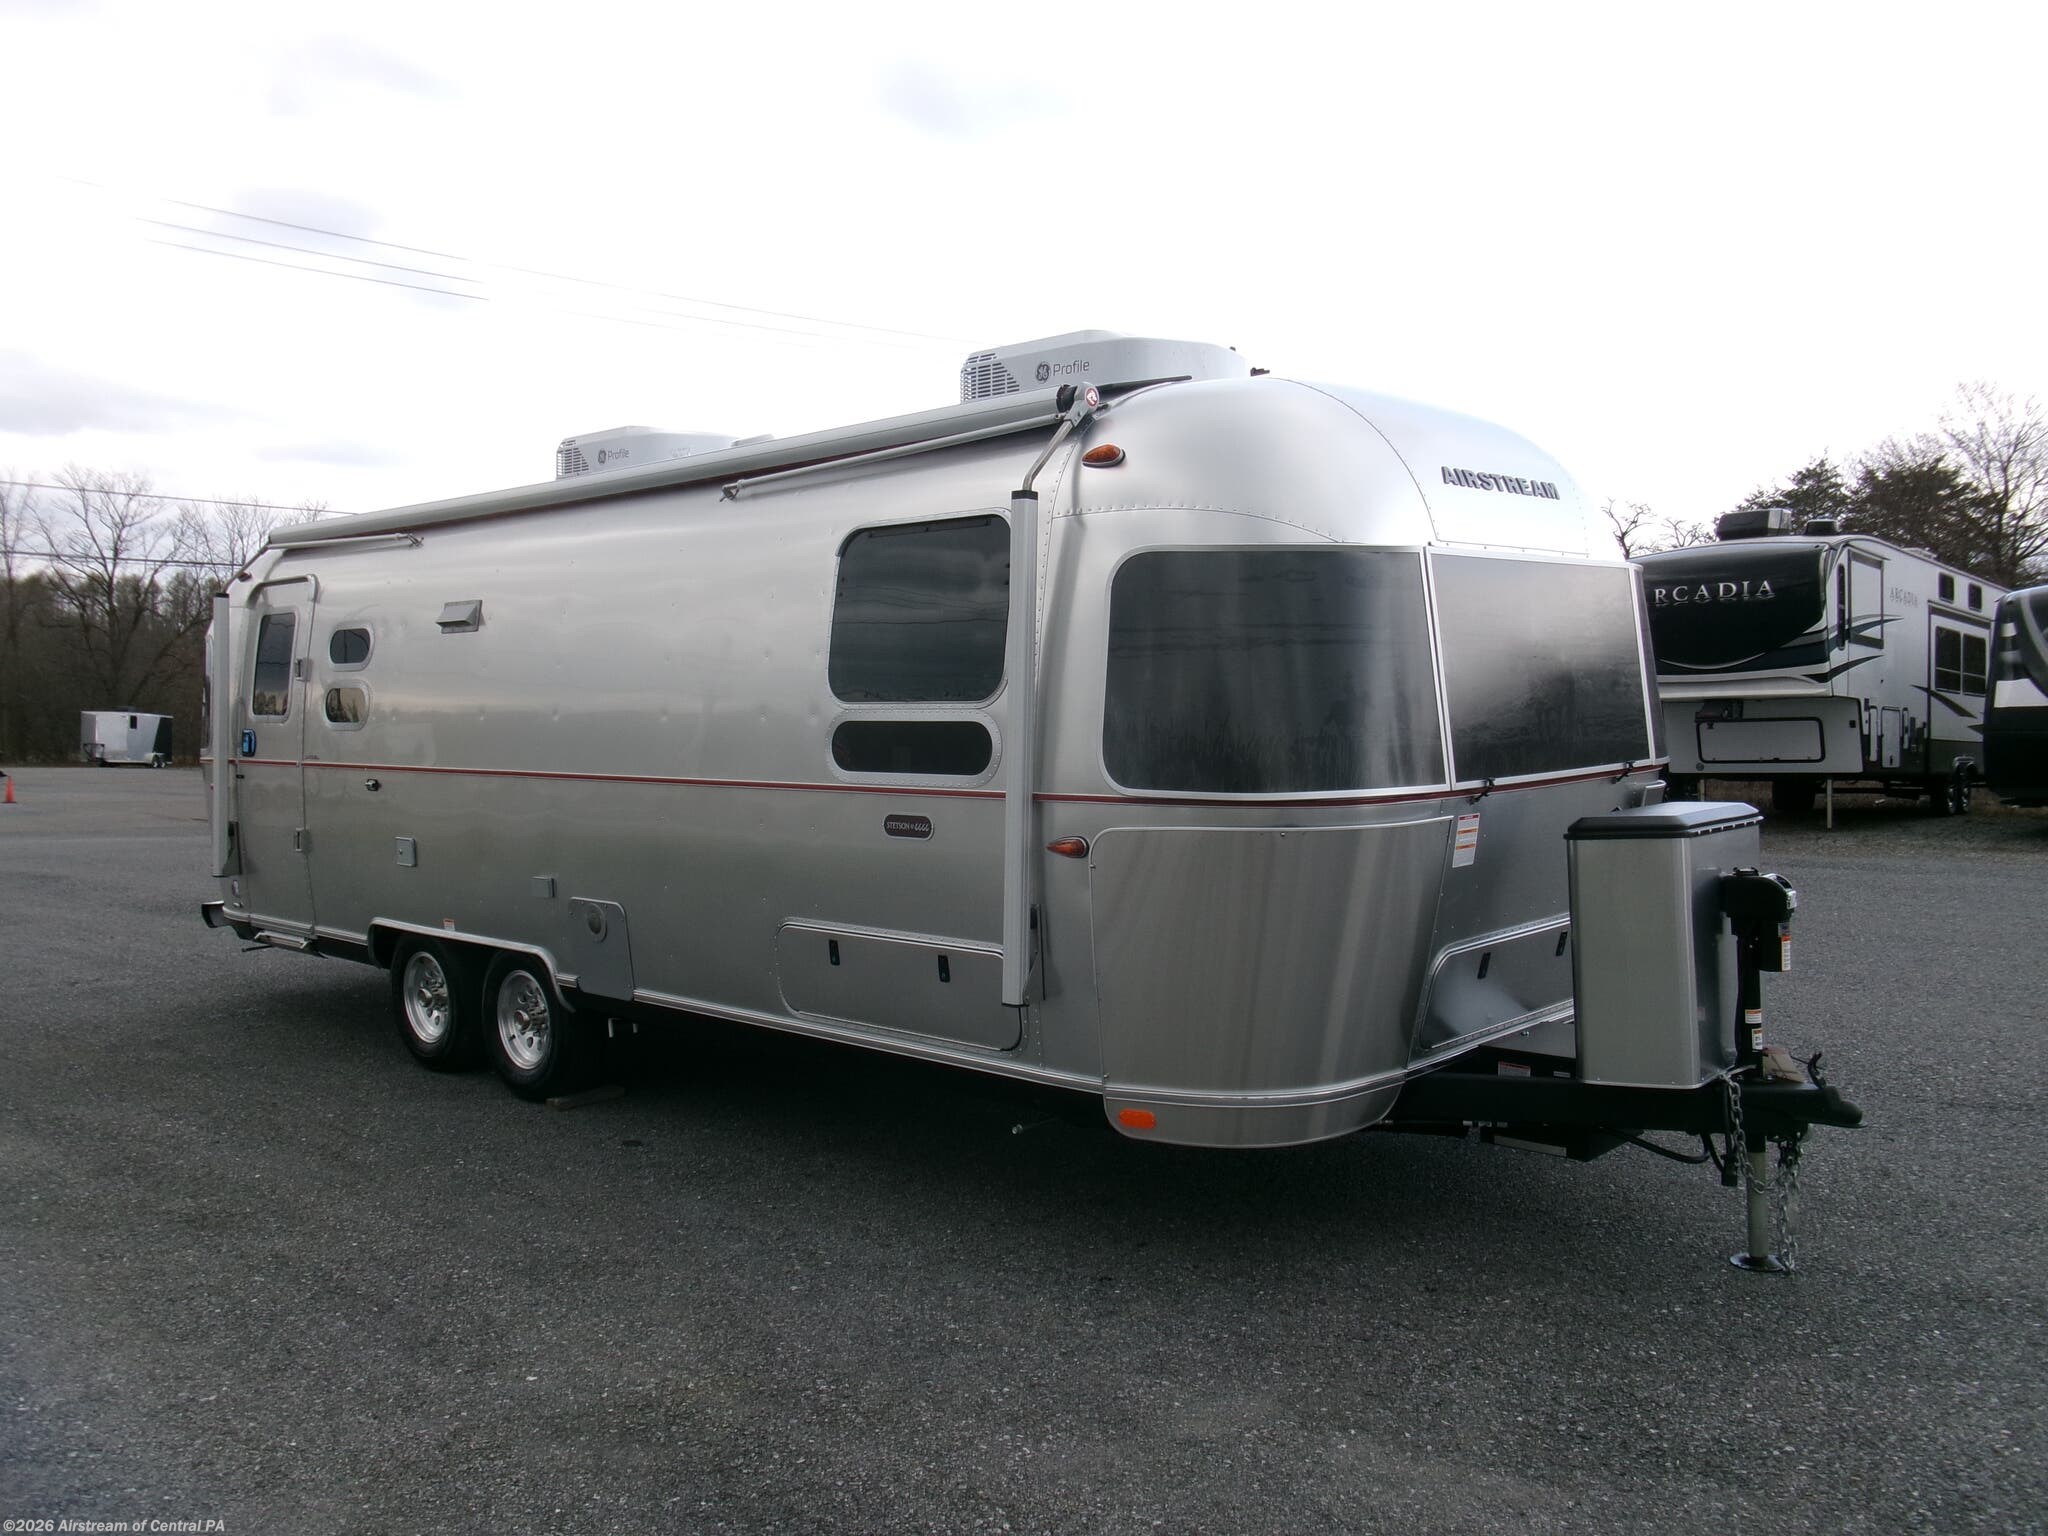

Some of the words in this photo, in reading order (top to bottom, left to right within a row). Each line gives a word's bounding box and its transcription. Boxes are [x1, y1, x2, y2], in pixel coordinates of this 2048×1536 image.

[1053, 359, 1090, 377] Profile
[1441, 466, 1560, 500] AIRSTREAM
[1654, 580, 1776, 605] RCADIA
